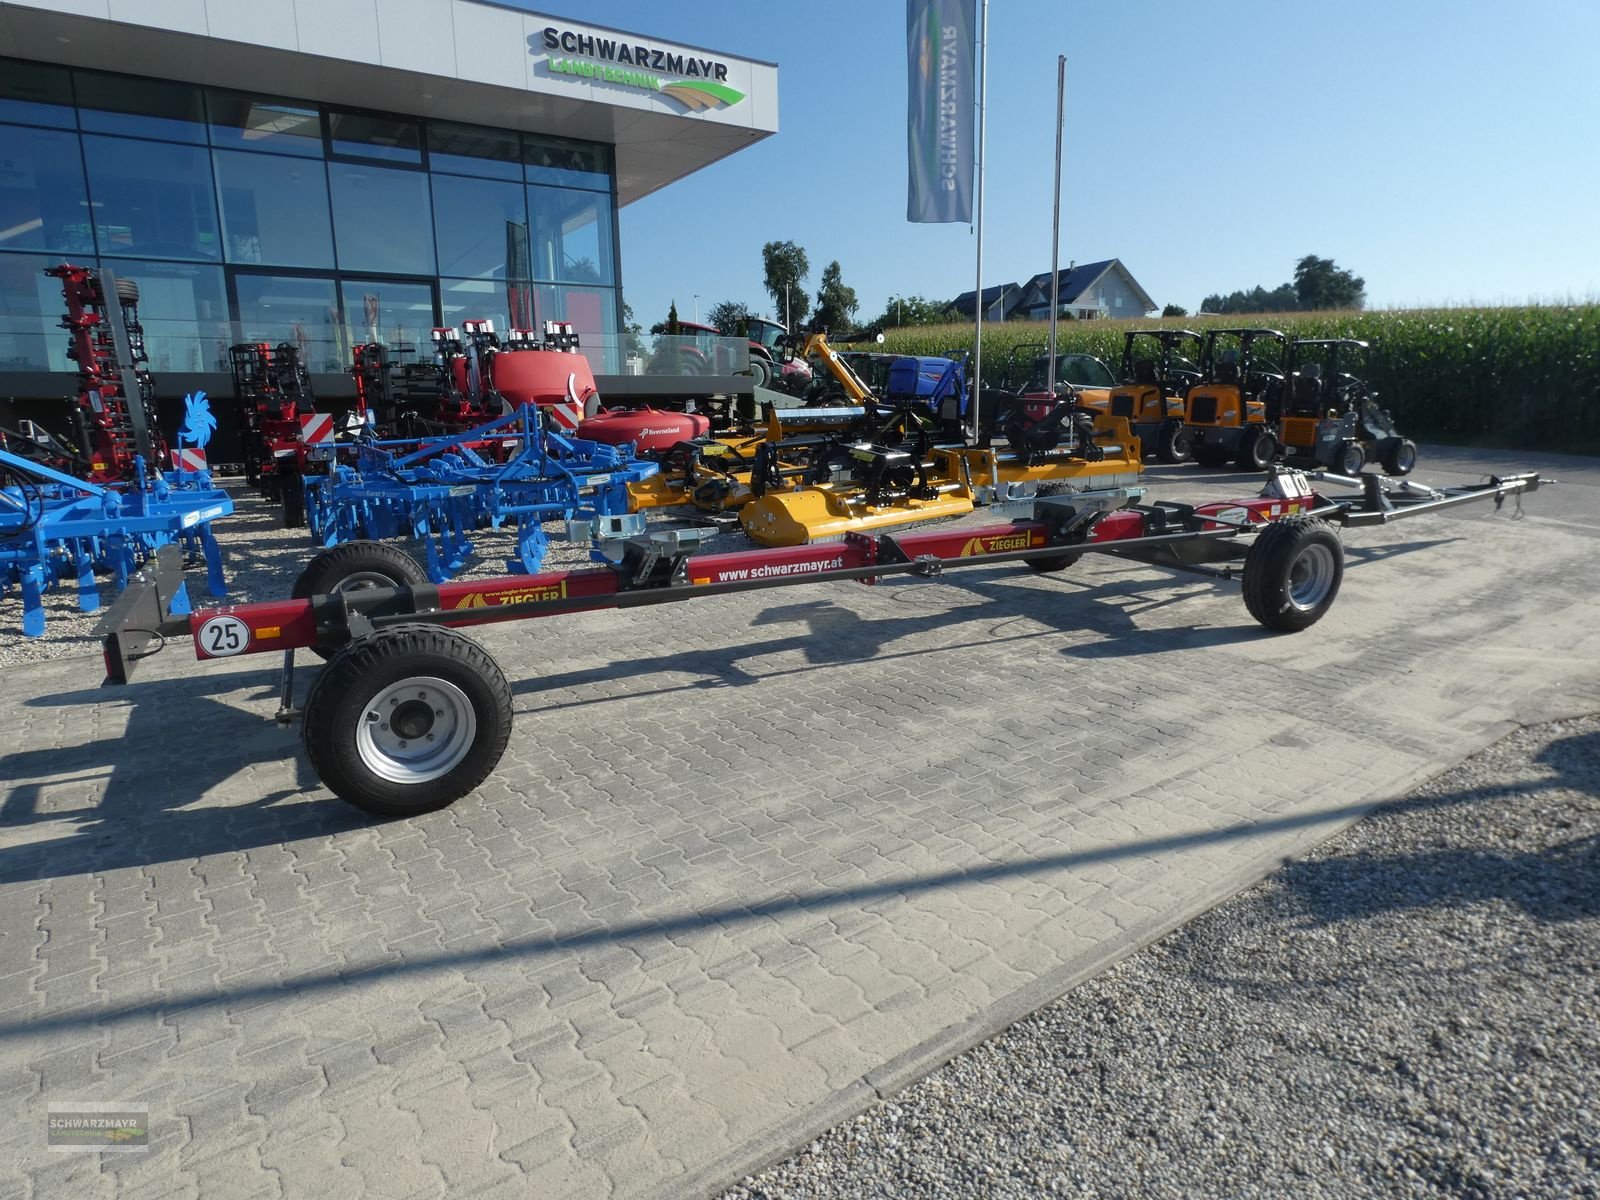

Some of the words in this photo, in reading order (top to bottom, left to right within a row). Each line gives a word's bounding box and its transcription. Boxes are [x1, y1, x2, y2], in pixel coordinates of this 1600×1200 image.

[543, 27, 728, 82] SCHWARZMAYR
[548, 56, 661, 92] LANDTECHNIK
[649, 426, 680, 435] Kverneland
[989, 538, 1026, 551] ZIEGLER
[209, 623, 240, 651] 25
